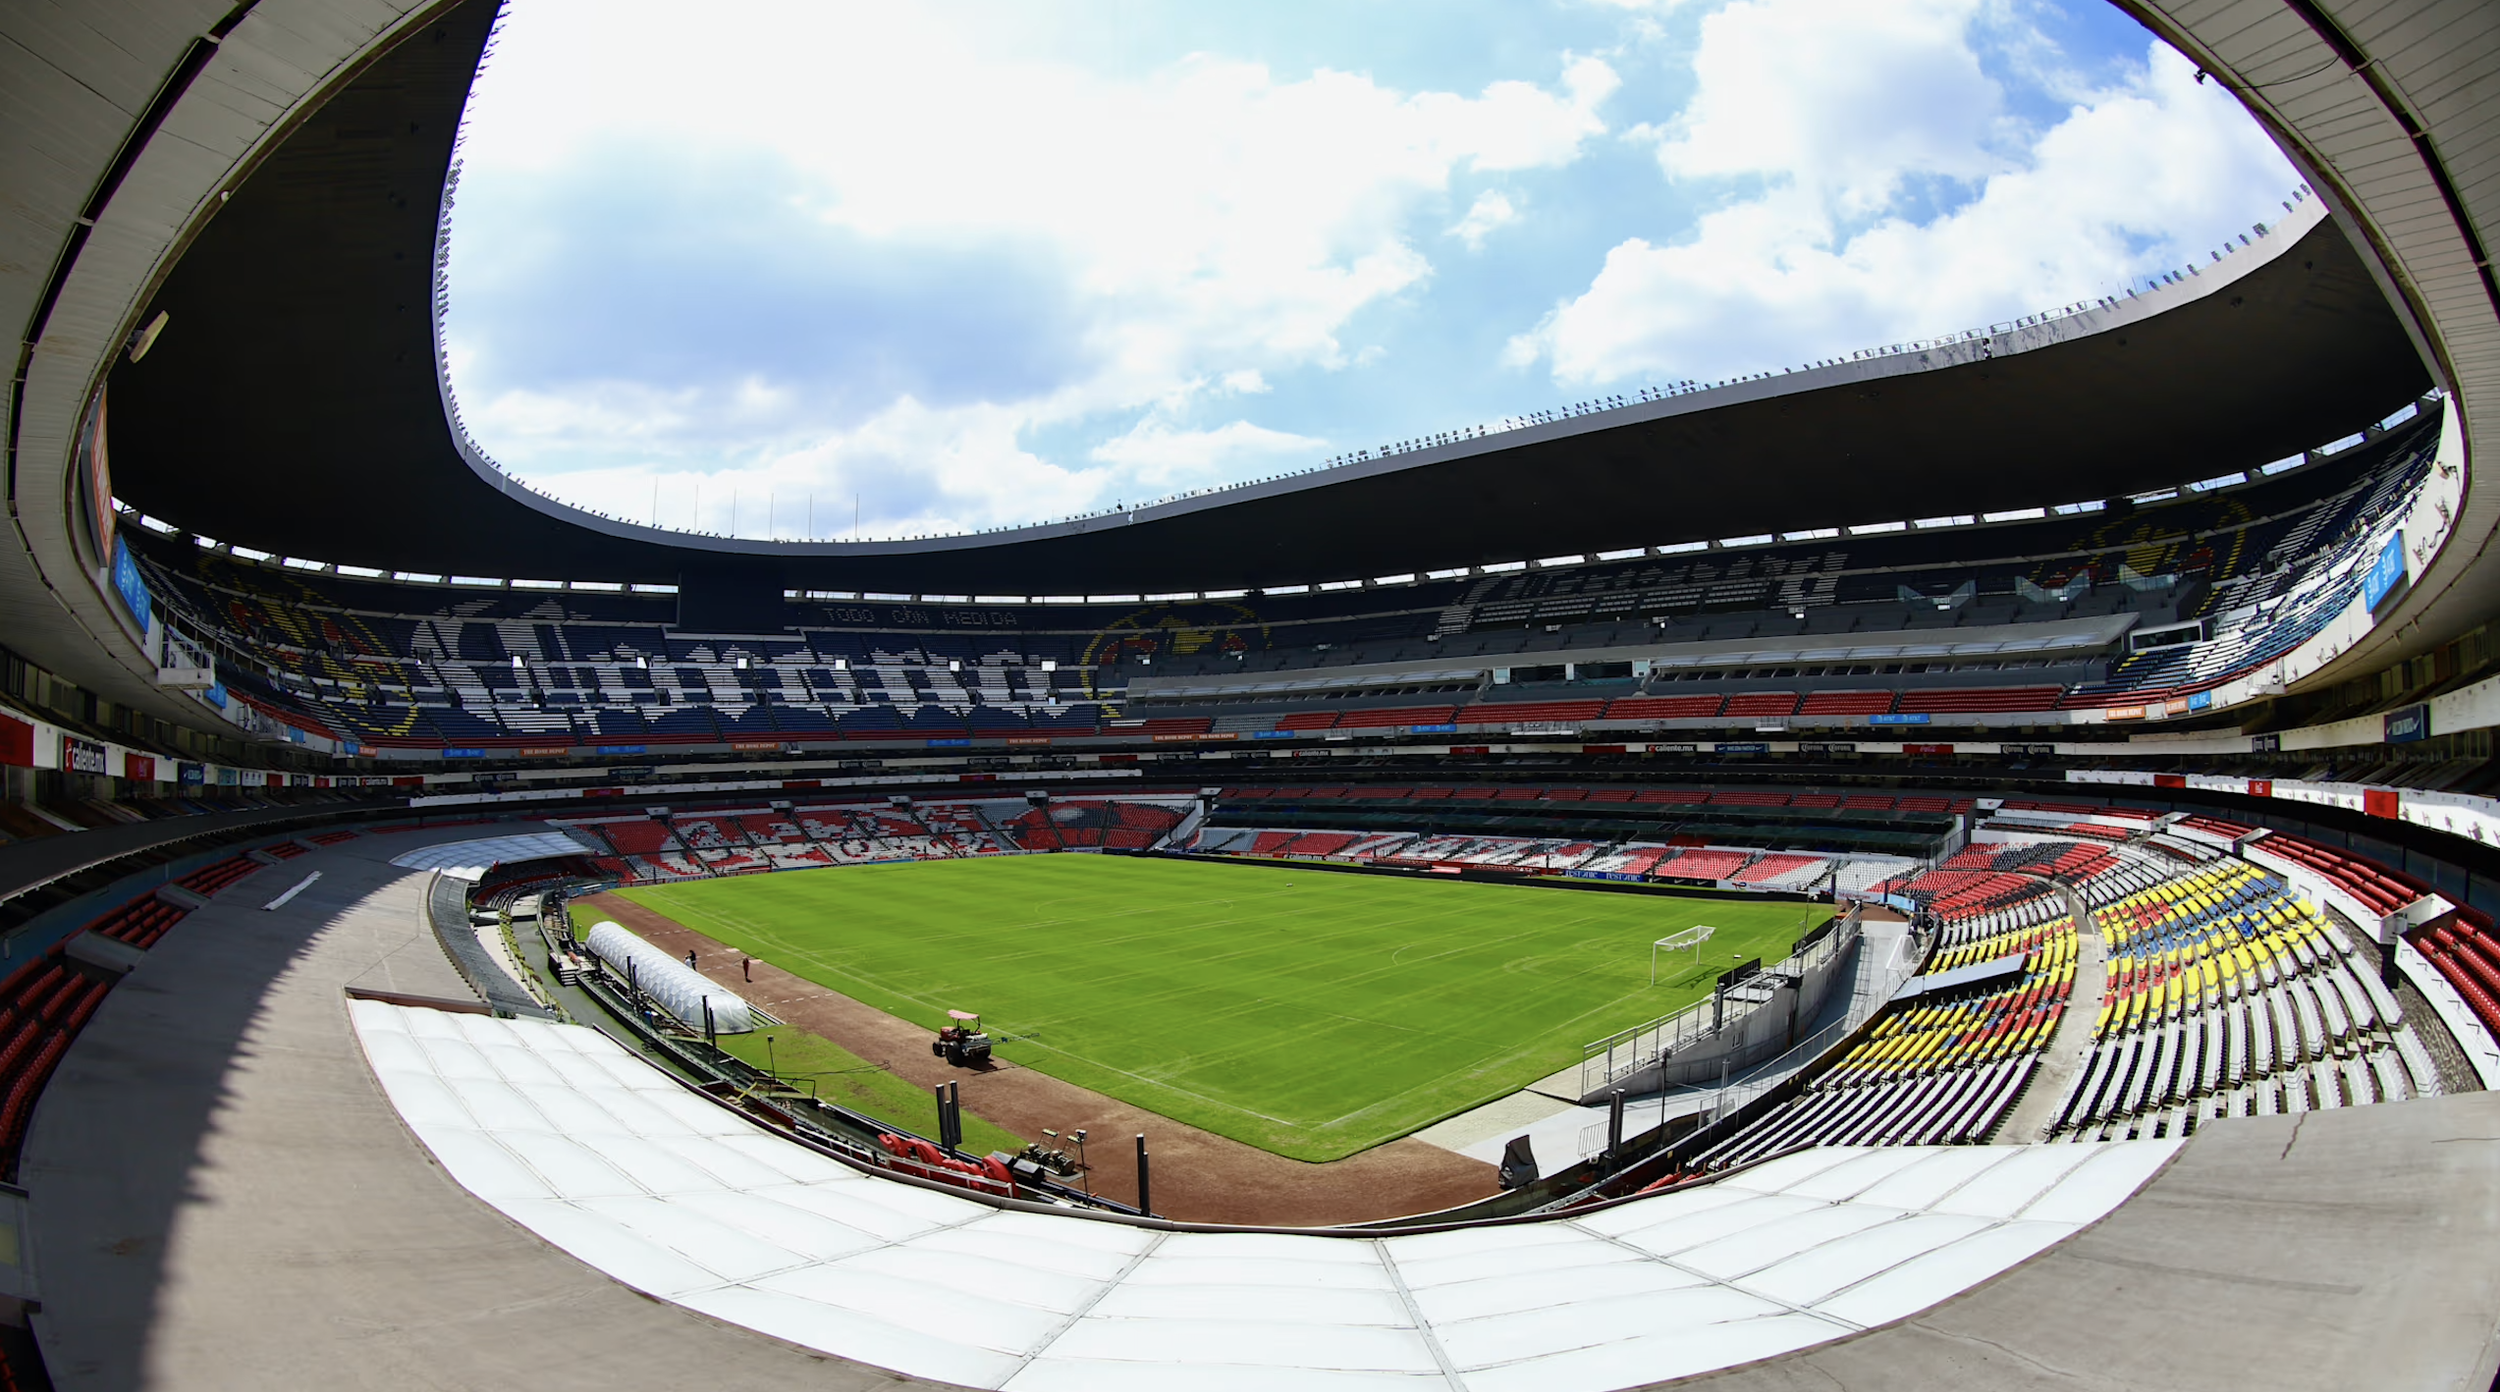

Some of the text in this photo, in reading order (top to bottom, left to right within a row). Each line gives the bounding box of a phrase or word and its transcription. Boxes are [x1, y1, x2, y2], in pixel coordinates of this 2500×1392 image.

[822, 608, 875, 623] TODO
[942, 611, 1018, 625] MEDIDA
[1655, 744, 1694, 752] caliente.mx
[1800, 743, 1850, 752] Corona Corona
[2002, 744, 2050, 754] Corona Corona
[72, 741, 105, 774] caliente.mx
